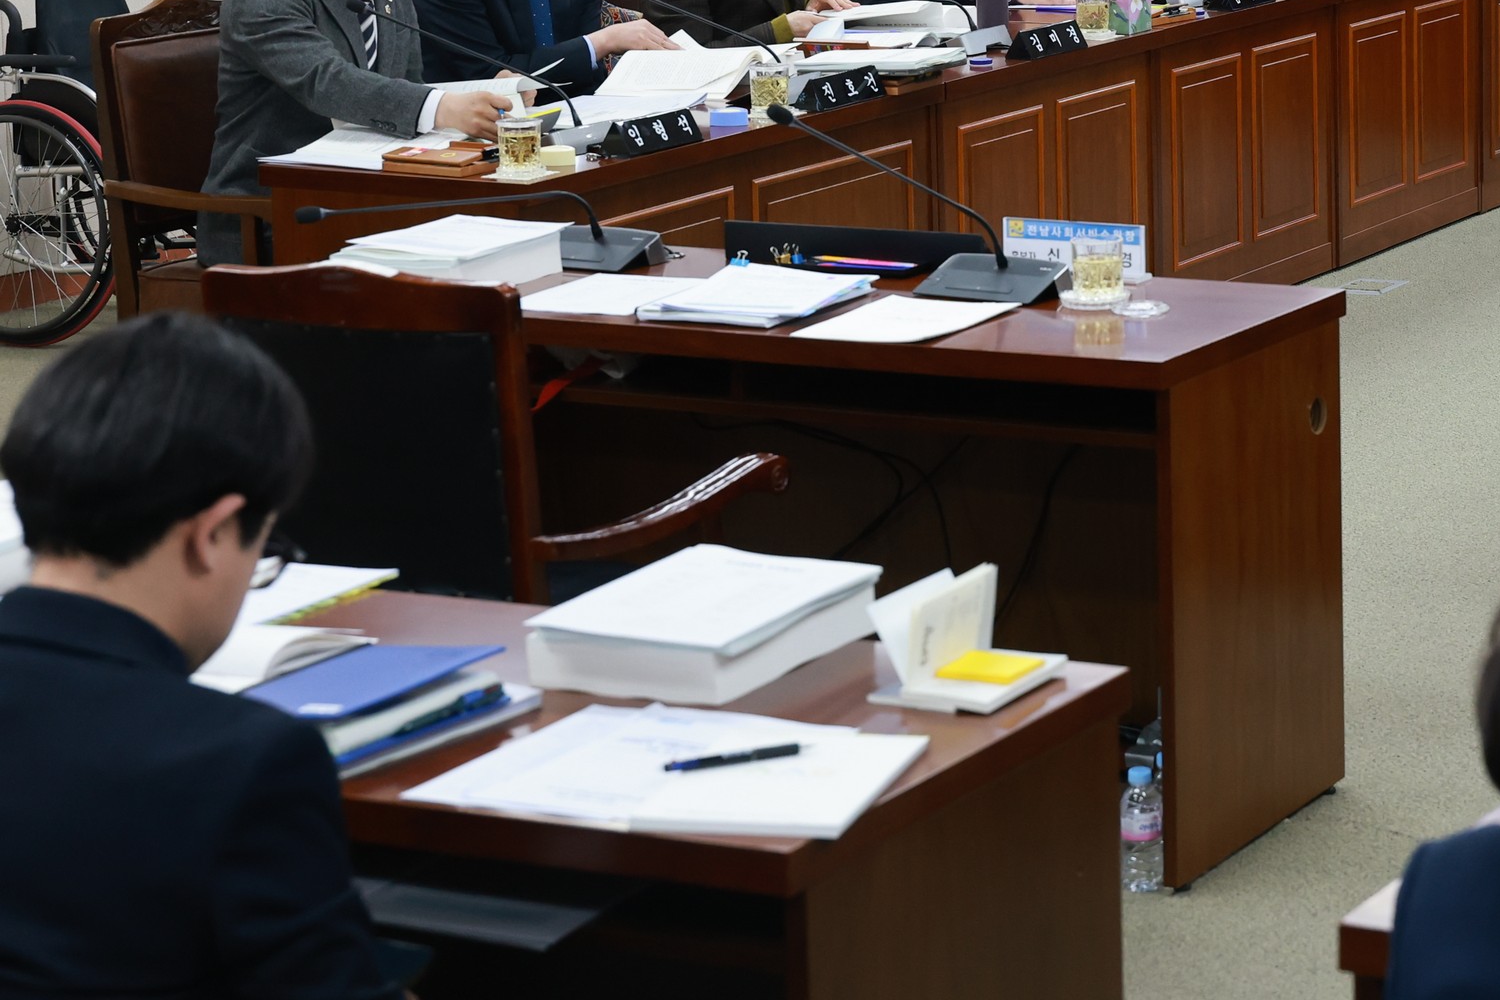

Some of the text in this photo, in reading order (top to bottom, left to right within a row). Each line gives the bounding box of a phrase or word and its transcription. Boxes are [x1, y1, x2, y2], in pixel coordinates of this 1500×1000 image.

[1029, 25, 1080, 52] 김미경
[821, 72, 879, 103] 진호건
[627, 114, 693, 147] 임형석
